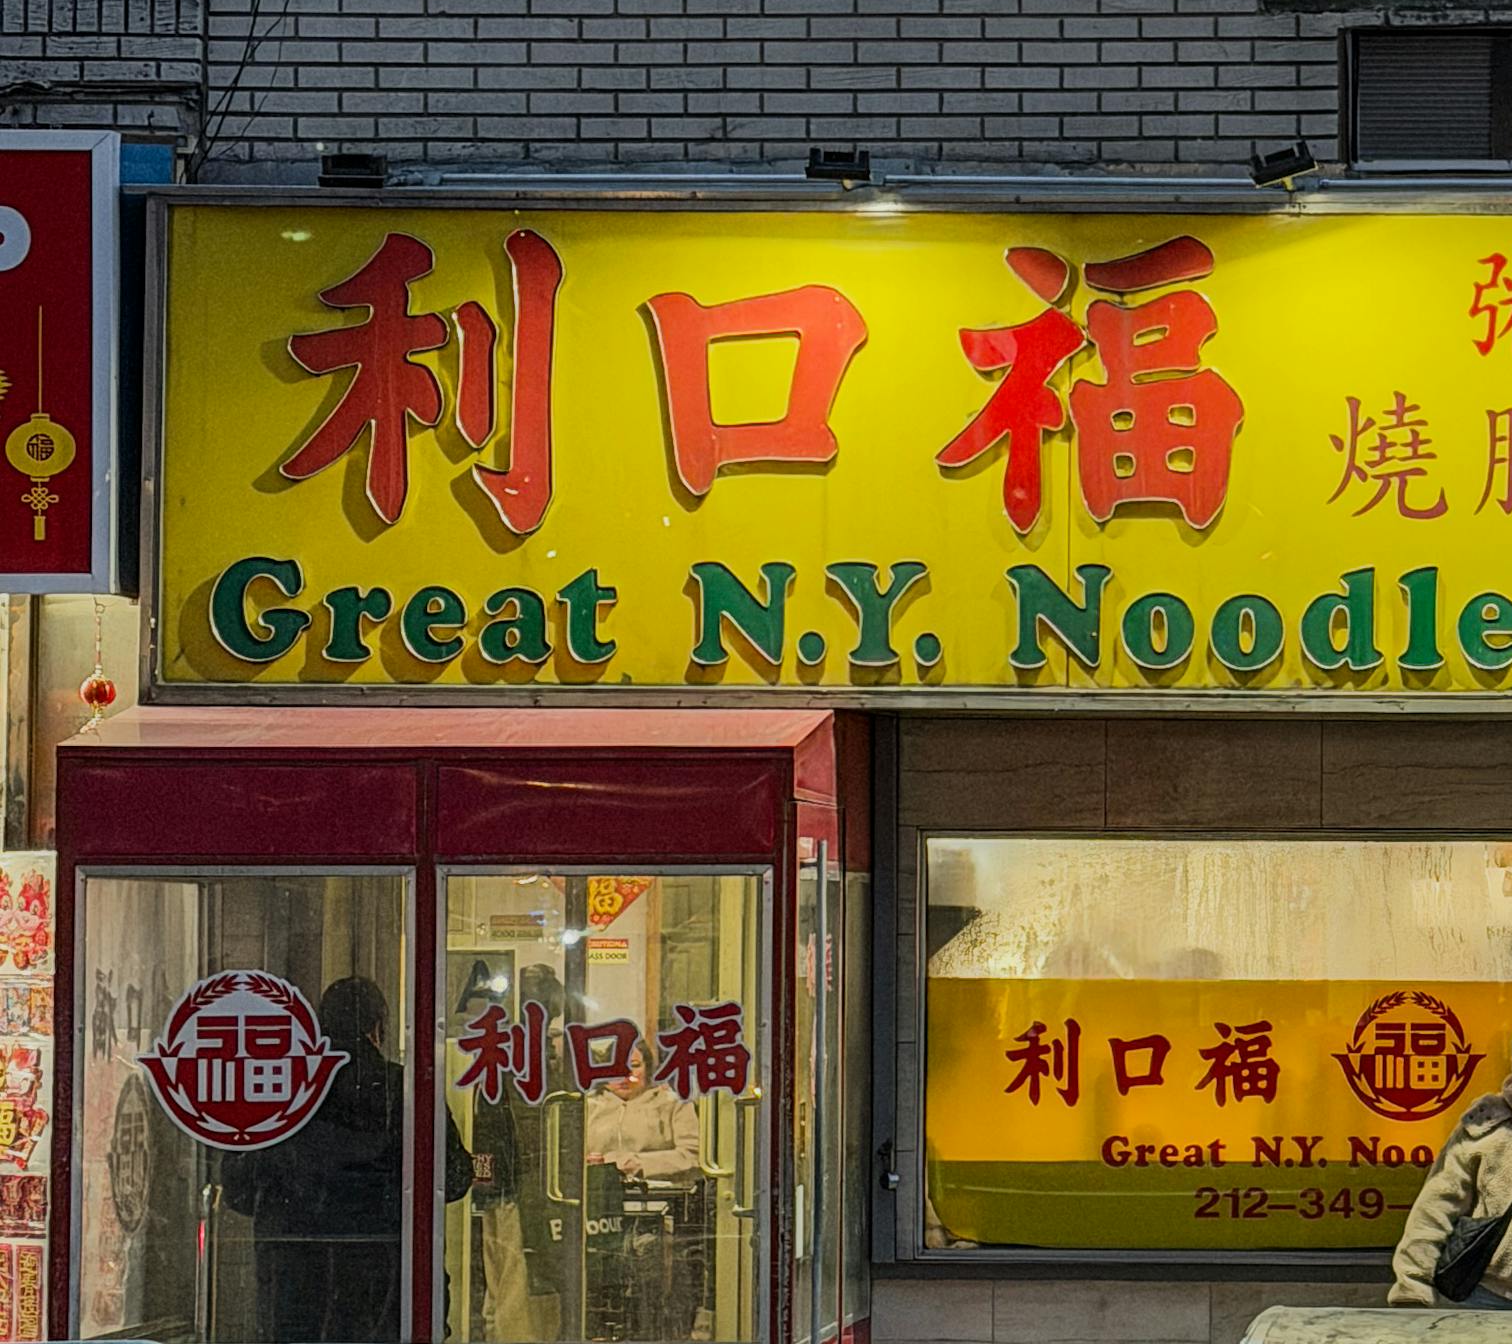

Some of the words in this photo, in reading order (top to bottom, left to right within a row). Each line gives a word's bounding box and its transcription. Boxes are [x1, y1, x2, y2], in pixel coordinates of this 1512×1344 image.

[279, 227, 1245, 536] 利口福
[208, 556, 618, 665] Great
[690, 560, 943, 669] N.Y.
[455, 1000, 753, 1106] 利口福
[1004, 1017, 1281, 1107] 利口福
[1100, 1135, 1227, 1169] Great
[1250, 1135, 1328, 1168] N.Y.
[1347, 1135, 1435, 1168] Noo
[1193, 1187, 1412, 1220] 212-349-
